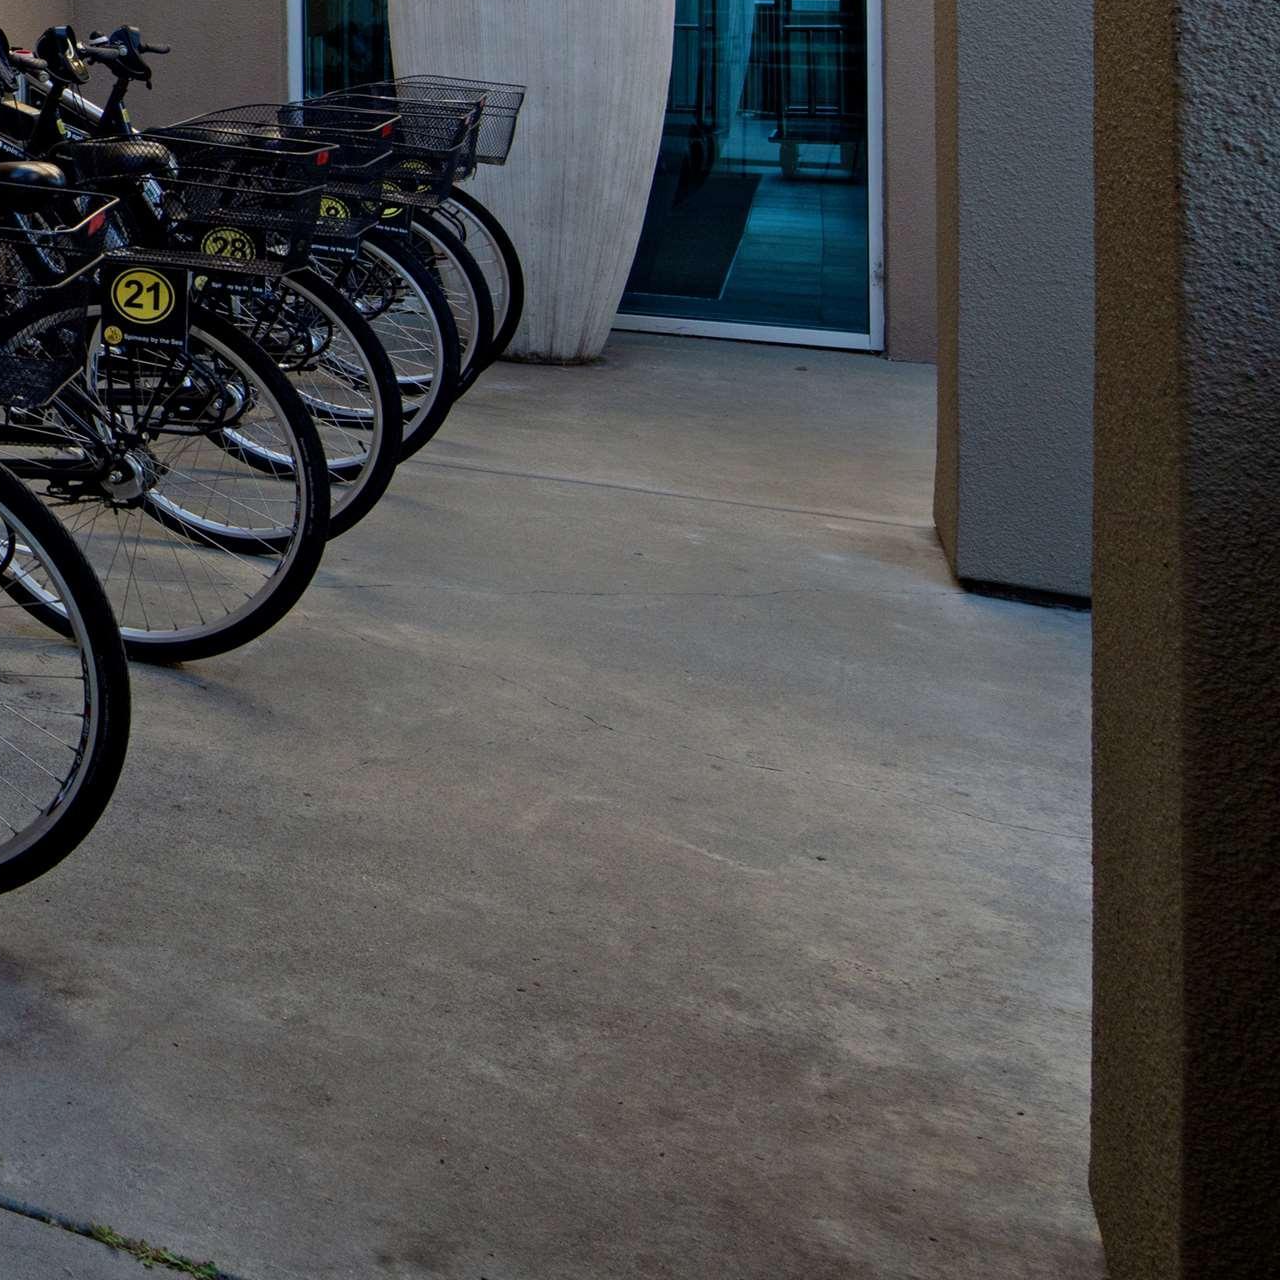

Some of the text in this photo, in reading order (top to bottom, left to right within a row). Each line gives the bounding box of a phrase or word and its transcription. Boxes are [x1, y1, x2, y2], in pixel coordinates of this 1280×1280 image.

[213, 236, 246, 260] 28
[124, 279, 160, 310] 21
[170, 338, 184, 346] Sea
